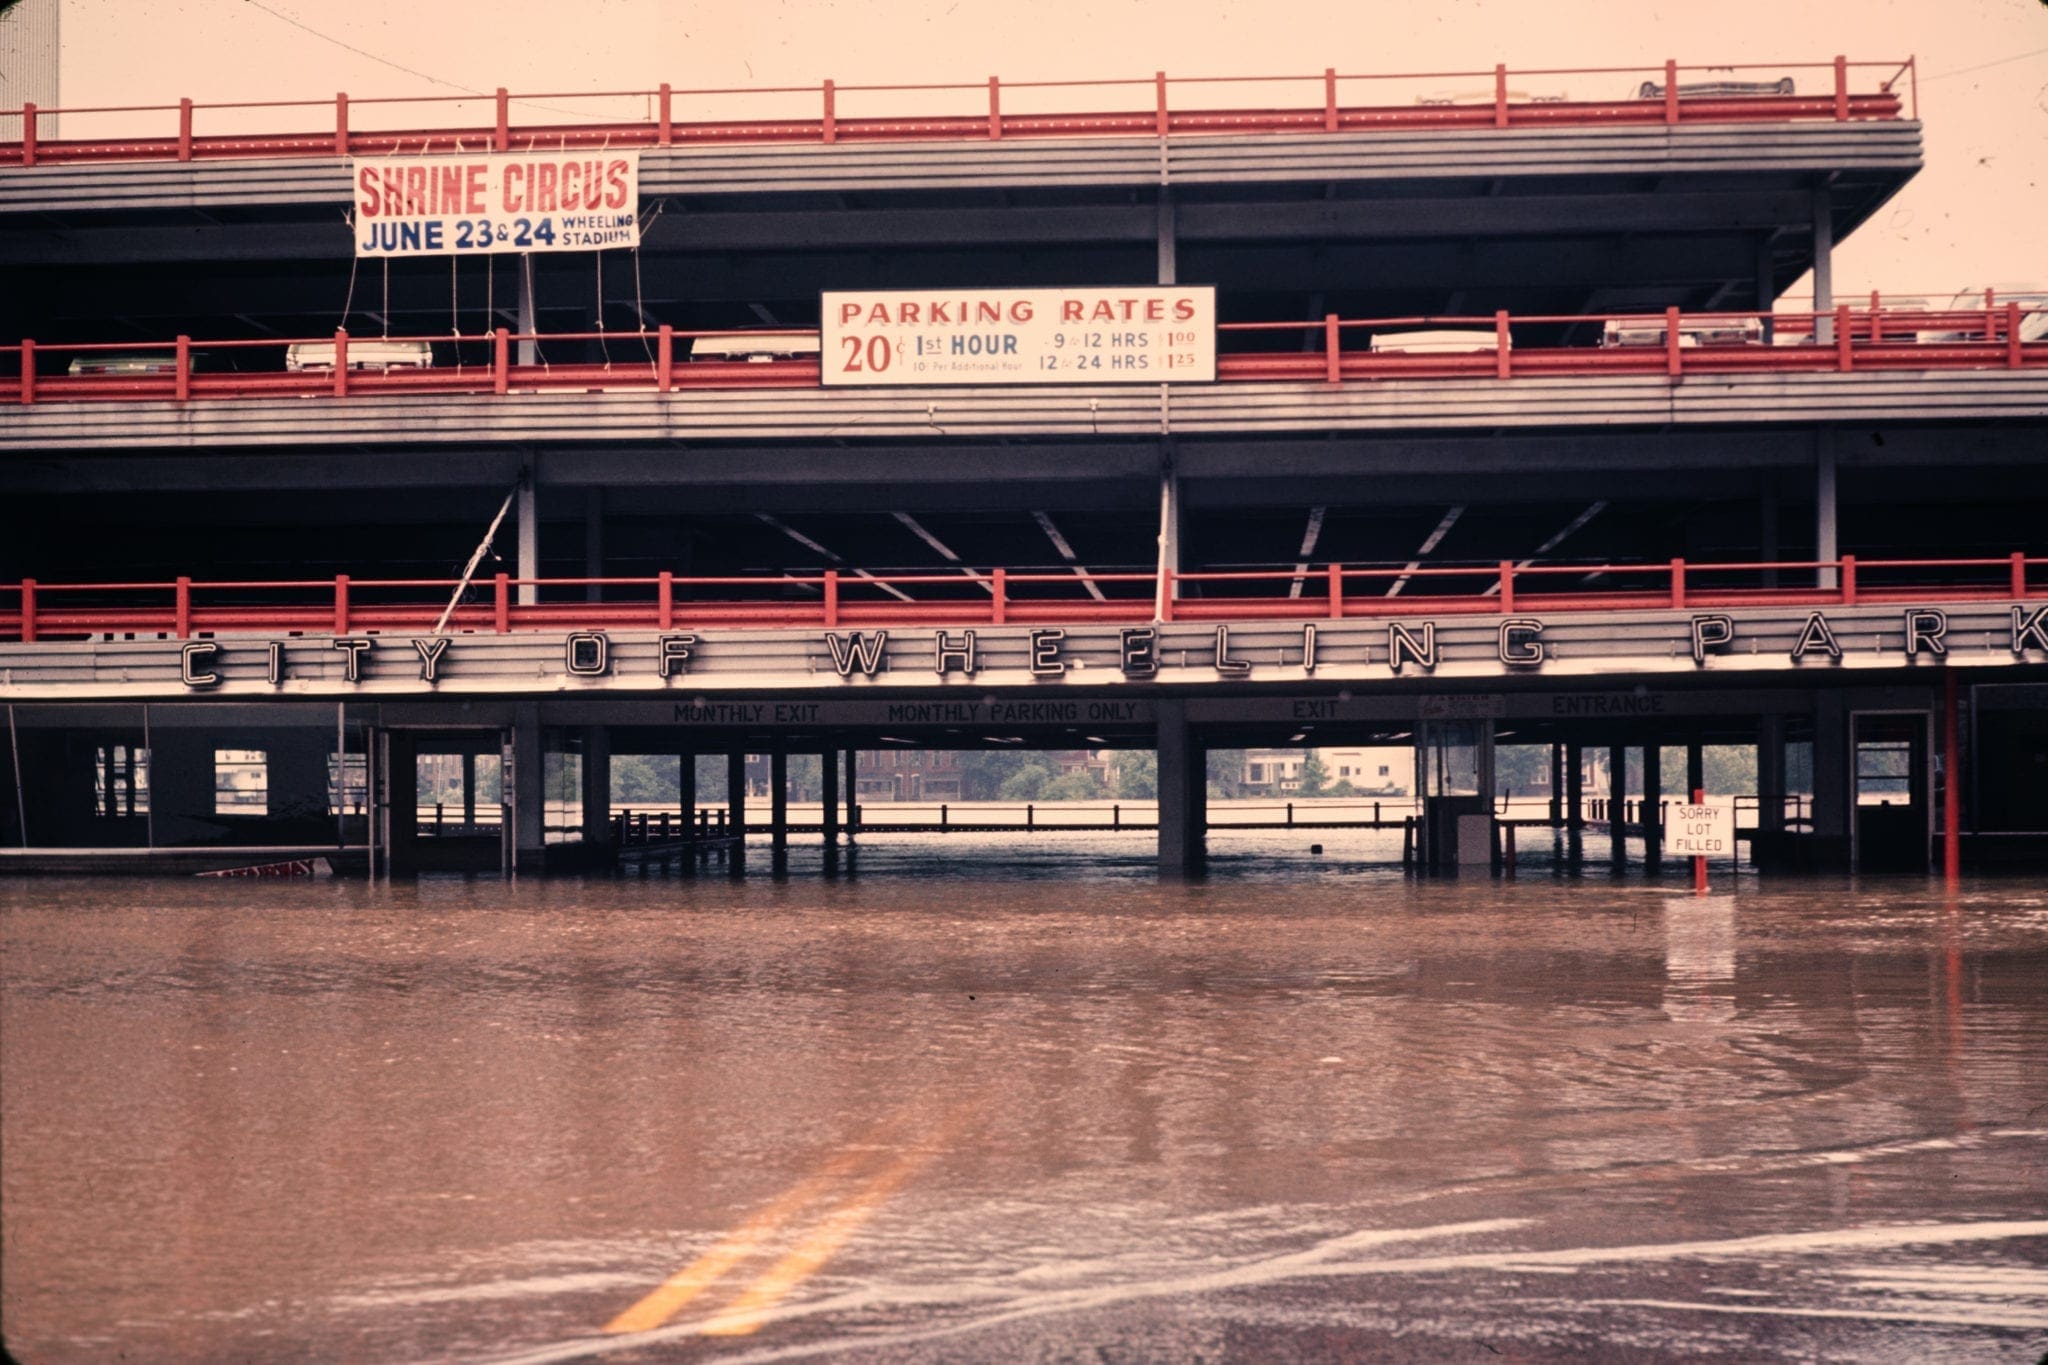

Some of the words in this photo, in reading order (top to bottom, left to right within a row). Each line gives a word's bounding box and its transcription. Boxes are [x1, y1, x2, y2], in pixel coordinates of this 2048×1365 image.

[359, 164, 488, 217] SHRINE
[502, 160, 629, 213] CIRCUS
[562, 214, 634, 229] WHEELING
[362, 220, 443, 251] JUNE
[456, 220, 494, 249] 23
[514, 218, 556, 247] 24
[563, 230, 631, 246] STADIUM
[839, 299, 1035, 325] PARKING
[1061, 298, 1196, 323] RATES
[951, 335, 1018, 355] HOUR
[1054, 333, 1065, 349] 9
[1084, 333, 1102, 347] 12
[1112, 332, 1149, 348] HRS
[1040, 355, 1058, 370] 12
[1077, 355, 1102, 369] 24
[1112, 354, 1149, 369] HRS
[181, 638, 452, 687] CITY
[565, 631, 698, 678] OF
[825, 618, 1546, 678] WHEELING
[673, 703, 764, 723] MONTHLY
[775, 703, 820, 723] EXIT
[888, 703, 980, 723] MONTHLY
[990, 702, 1079, 722] PARKING
[1087, 702, 1137, 721] ONLY
[1292, 699, 1339, 718] EXIT
[1552, 695, 1666, 715] ENTRANCE
[1679, 807, 1720, 820] SORRY
[1687, 823, 1712, 835] LOT
[1676, 839, 1722, 851] FILLED
